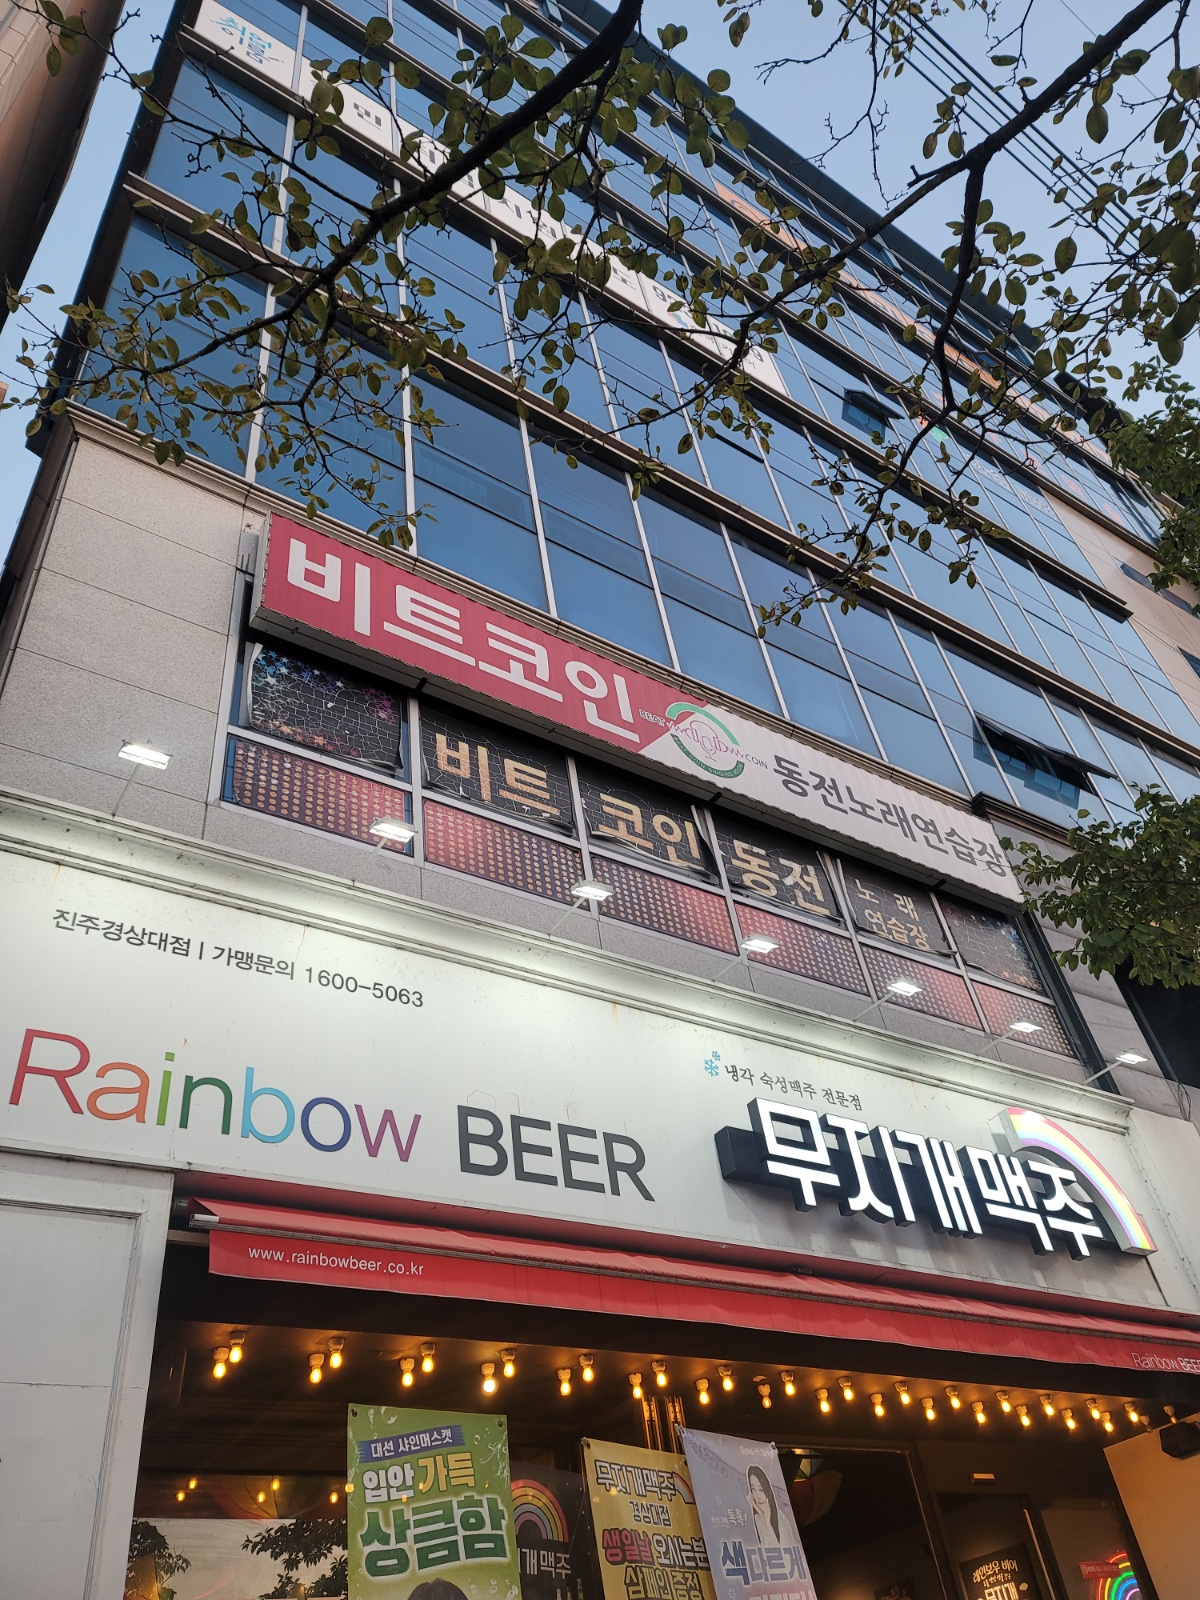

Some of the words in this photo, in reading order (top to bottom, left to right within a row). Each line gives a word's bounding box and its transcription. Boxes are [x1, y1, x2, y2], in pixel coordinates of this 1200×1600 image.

[287, 537, 640, 743] 비트코인
[638, 708, 665, 727] BEAT
[744, 753, 768, 769] COIN
[435, 732, 560, 816] 비트
[598, 791, 706, 872] 코인
[731, 839, 830, 917] 동전
[773, 754, 1007, 878] 동전노래연습장
[864, 907, 931, 950] 연습장
[52, 908, 191, 957] 진주경상대점
[211, 945, 295, 981] 가맹문의
[304, 966, 424, 1008] 1600-5063
[724, 1064, 755, 1086] 냉각
[759, 1072, 817, 1100] 숙성맥주
[821, 1088, 863, 1111] 전문점
[9, 1028, 422, 1163] Rainbow
[456, 1104, 656, 1203] BEER
[755, 1097, 1104, 1260] 무지개맥주
[248, 1245, 424, 1277] www.rainbowbeer.co.kr
[1131, 1352, 1180, 1370] Rainbow
[370, 1442, 395, 1459] 대선
[398, 1428, 454, 1453] 샤인머스캣
[362, 1462, 415, 1504] 입안
[417, 1451, 476, 1495] 가득
[594, 1459, 676, 1502] 무지개맥주
[359, 1494, 509, 1578] 상큼함
[628, 1500, 673, 1527] 경상대점
[602, 1528, 655, 1565] 생일날
[652, 1533, 710, 1571] 오시는분
[721, 1539, 807, 1587] 색다르게
[971, 1560, 1001, 1584] 레인보우
[1001, 1558, 1019, 1572] 비어
